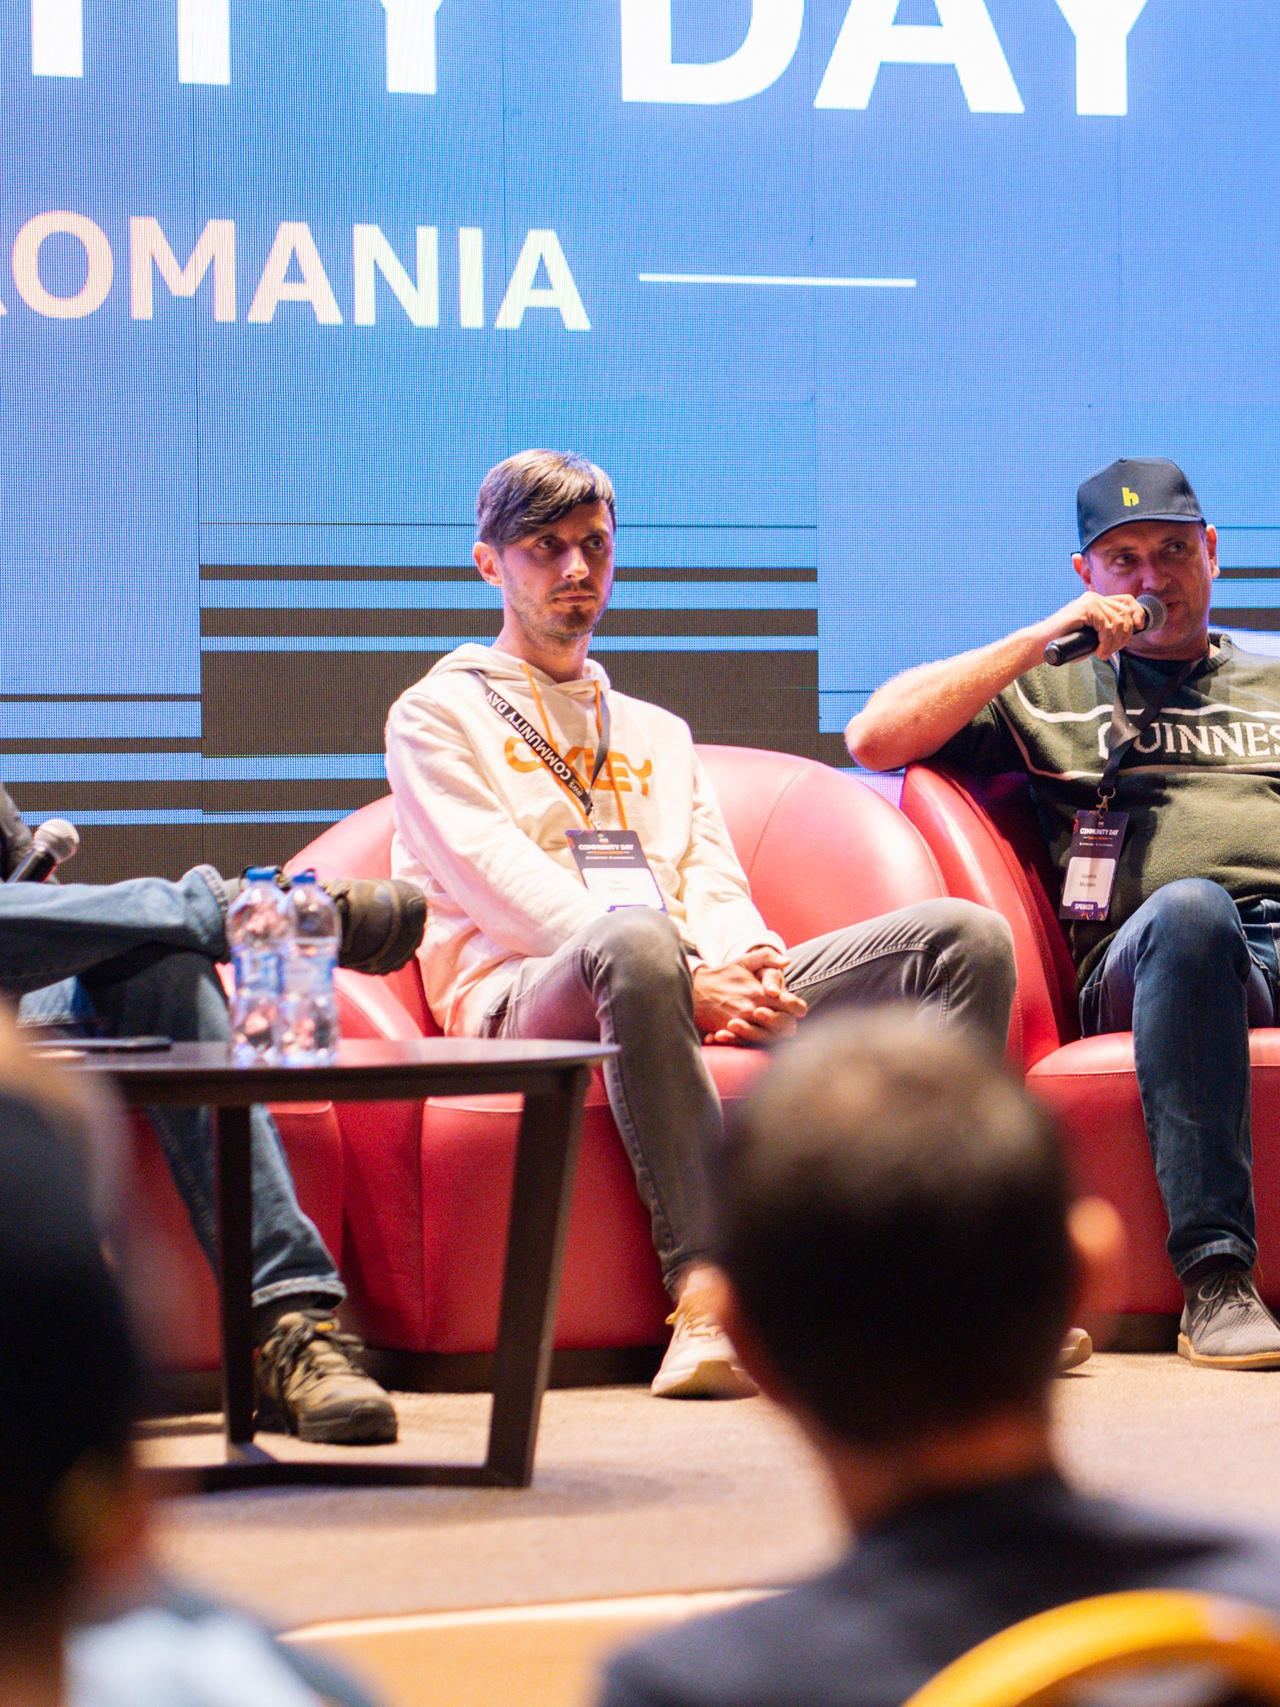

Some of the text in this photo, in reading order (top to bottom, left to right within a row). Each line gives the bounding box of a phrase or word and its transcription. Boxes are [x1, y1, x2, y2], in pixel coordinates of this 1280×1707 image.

[0, 209, 592, 331] OMANIA
[486, 691, 510, 714] DAY
[504, 736, 652, 797] OKLEY
[505, 711, 572, 780] COMMUNITY
